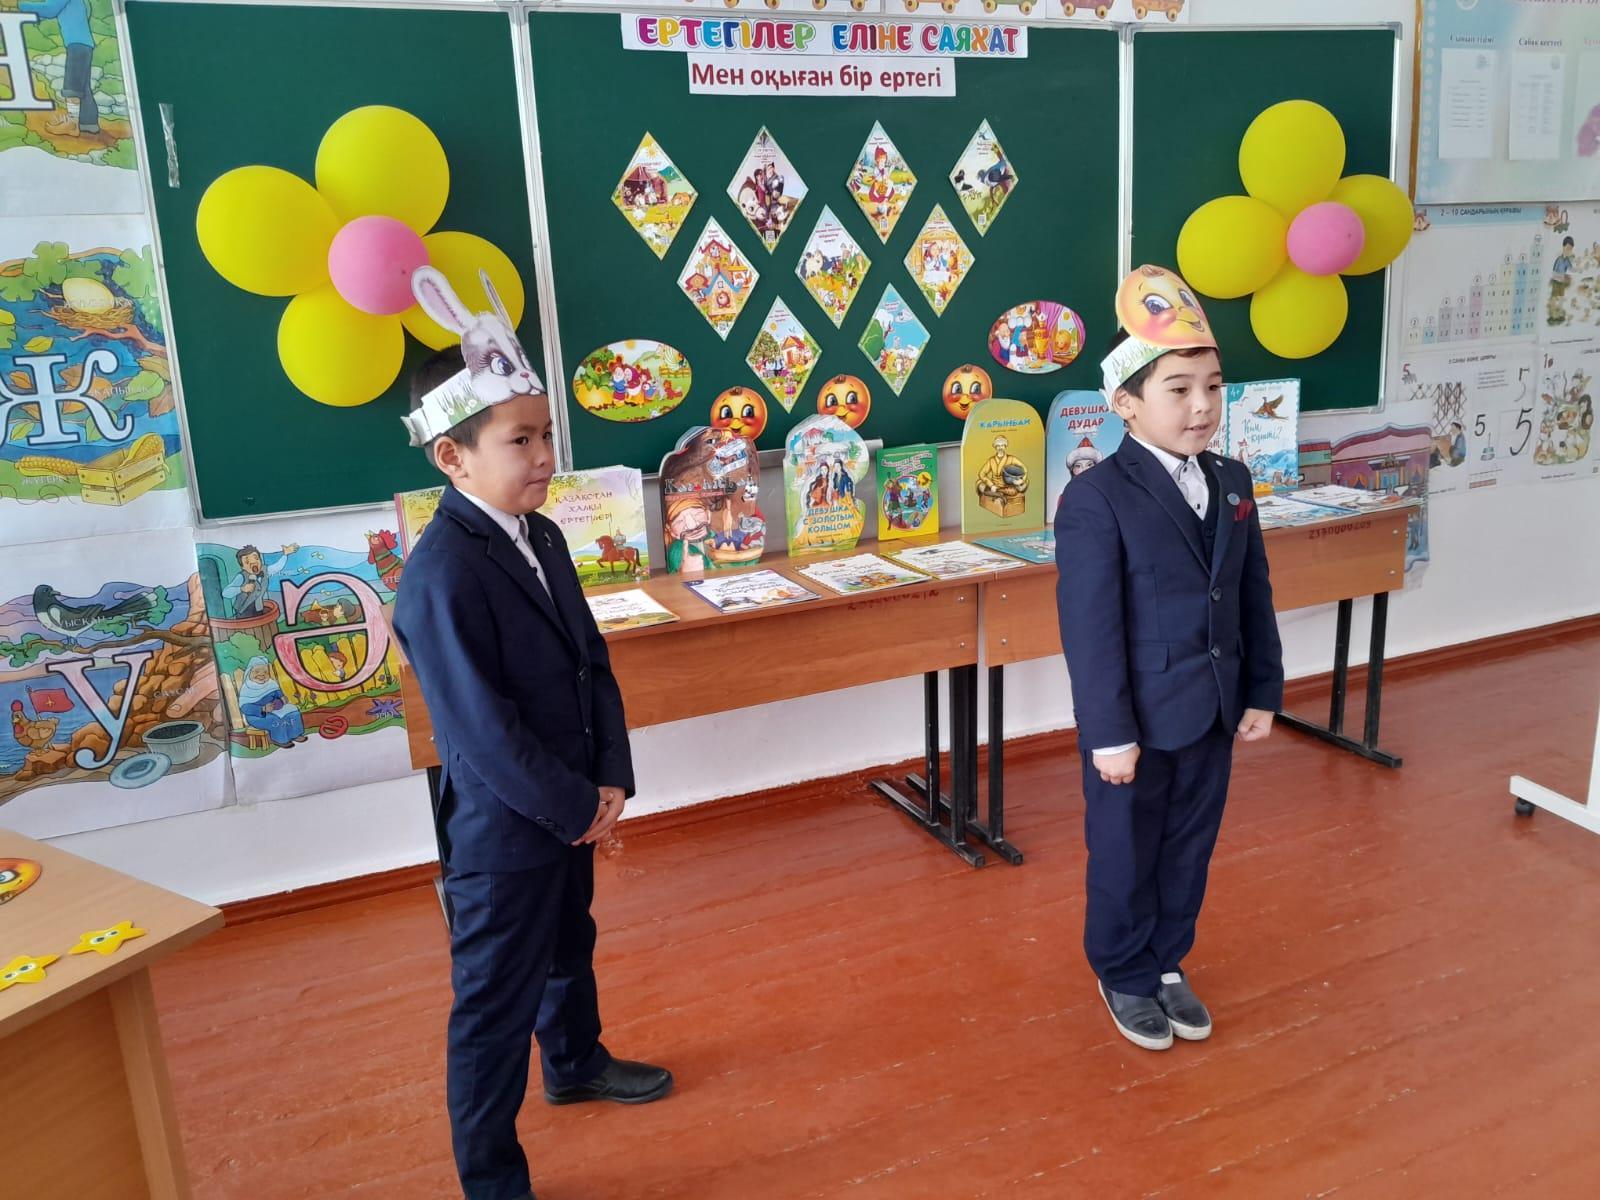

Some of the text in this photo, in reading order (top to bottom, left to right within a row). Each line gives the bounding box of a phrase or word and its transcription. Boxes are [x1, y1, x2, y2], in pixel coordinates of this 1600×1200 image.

[637, 17, 1019, 53] ЕРТЕГІЛЕР ЕЛІНЕ САЯХАТ
[692, 63, 941, 92] Мен оқыған бір ертегі
[1067, 417, 1105, 431] ДУДАР
[1474, 413, 1486, 437] 5
[1509, 407, 1534, 456] 5
[807, 505, 849, 516] ДЕВУШКА
[811, 514, 855, 525] ЗОЛОТЫМ
[807, 523, 851, 534] КОЛЬЦОМ
